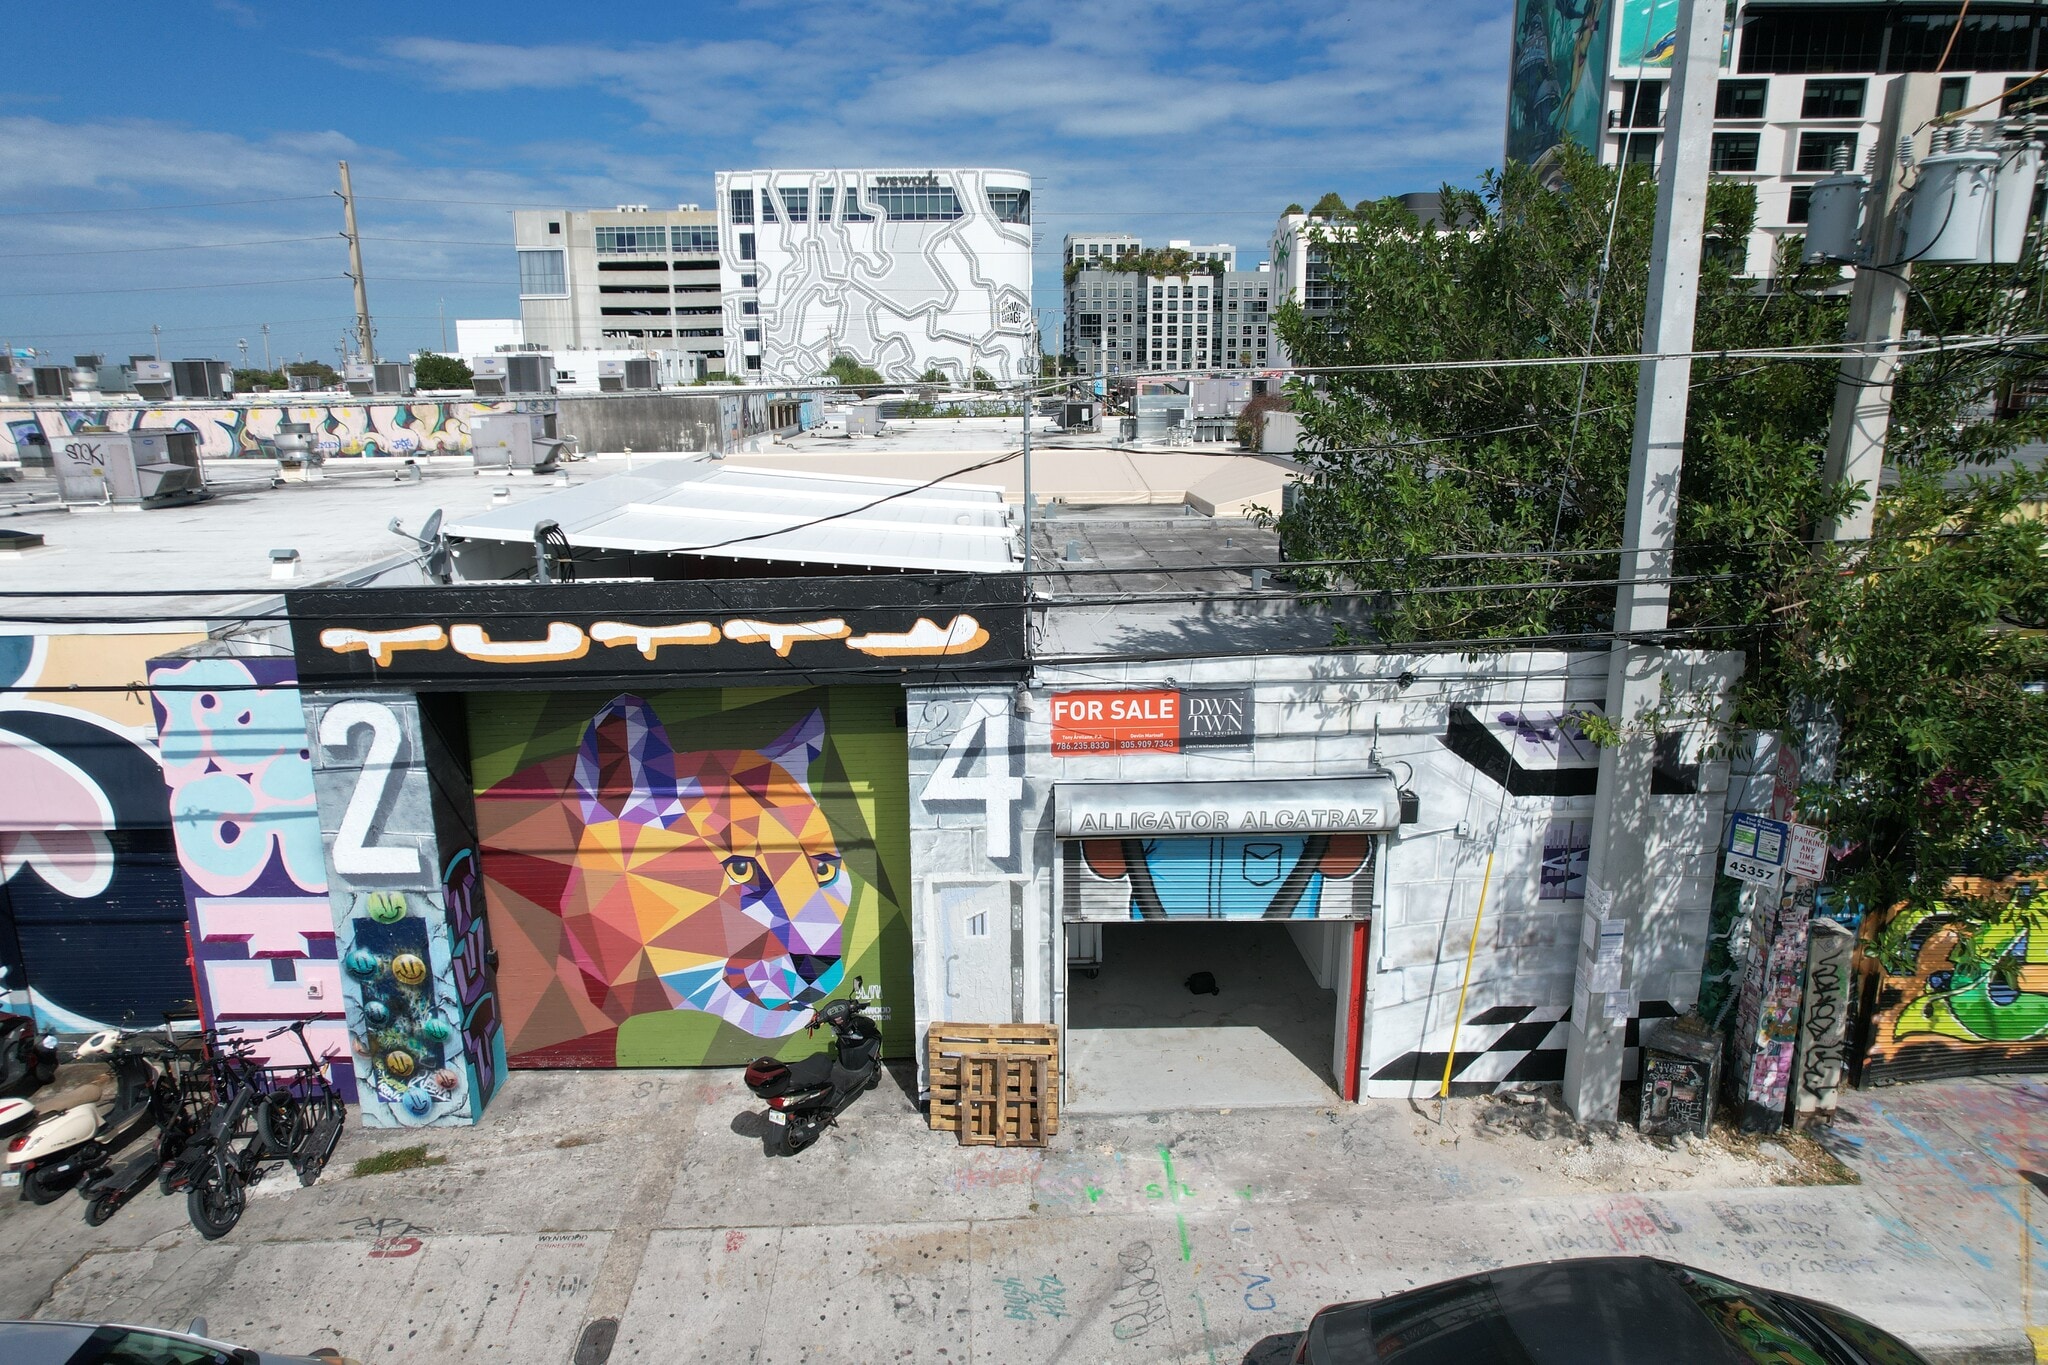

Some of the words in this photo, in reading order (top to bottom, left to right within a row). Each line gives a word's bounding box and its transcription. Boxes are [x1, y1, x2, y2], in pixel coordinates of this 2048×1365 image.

[875, 170, 939, 186] wework
[1054, 700, 1104, 721] FOR
[1110, 699, 1174, 720] SALE
[1188, 698, 1245, 715] DWN
[1187, 714, 1244, 732] TWN
[1056, 741, 1110, 750] 786.235.8330
[1120, 739, 1174, 749] 305.909.7343
[919, 692, 1025, 859] 4
[319, 698, 424, 877] 2
[1079, 810, 1229, 832] ALLIGATOR
[1240, 808, 1379, 830] ALCATRAZ
[1805, 829, 1816, 838] NO
[1794, 835, 1825, 849] PARKING
[1801, 844, 1816, 854] ANY
[1799, 851, 1816, 862] TIME
[1729, 861, 1775, 880] 45357
[538, 1233, 588, 1242] WYNWOOD
[534, 1242, 585, 1250] CONNECTION
